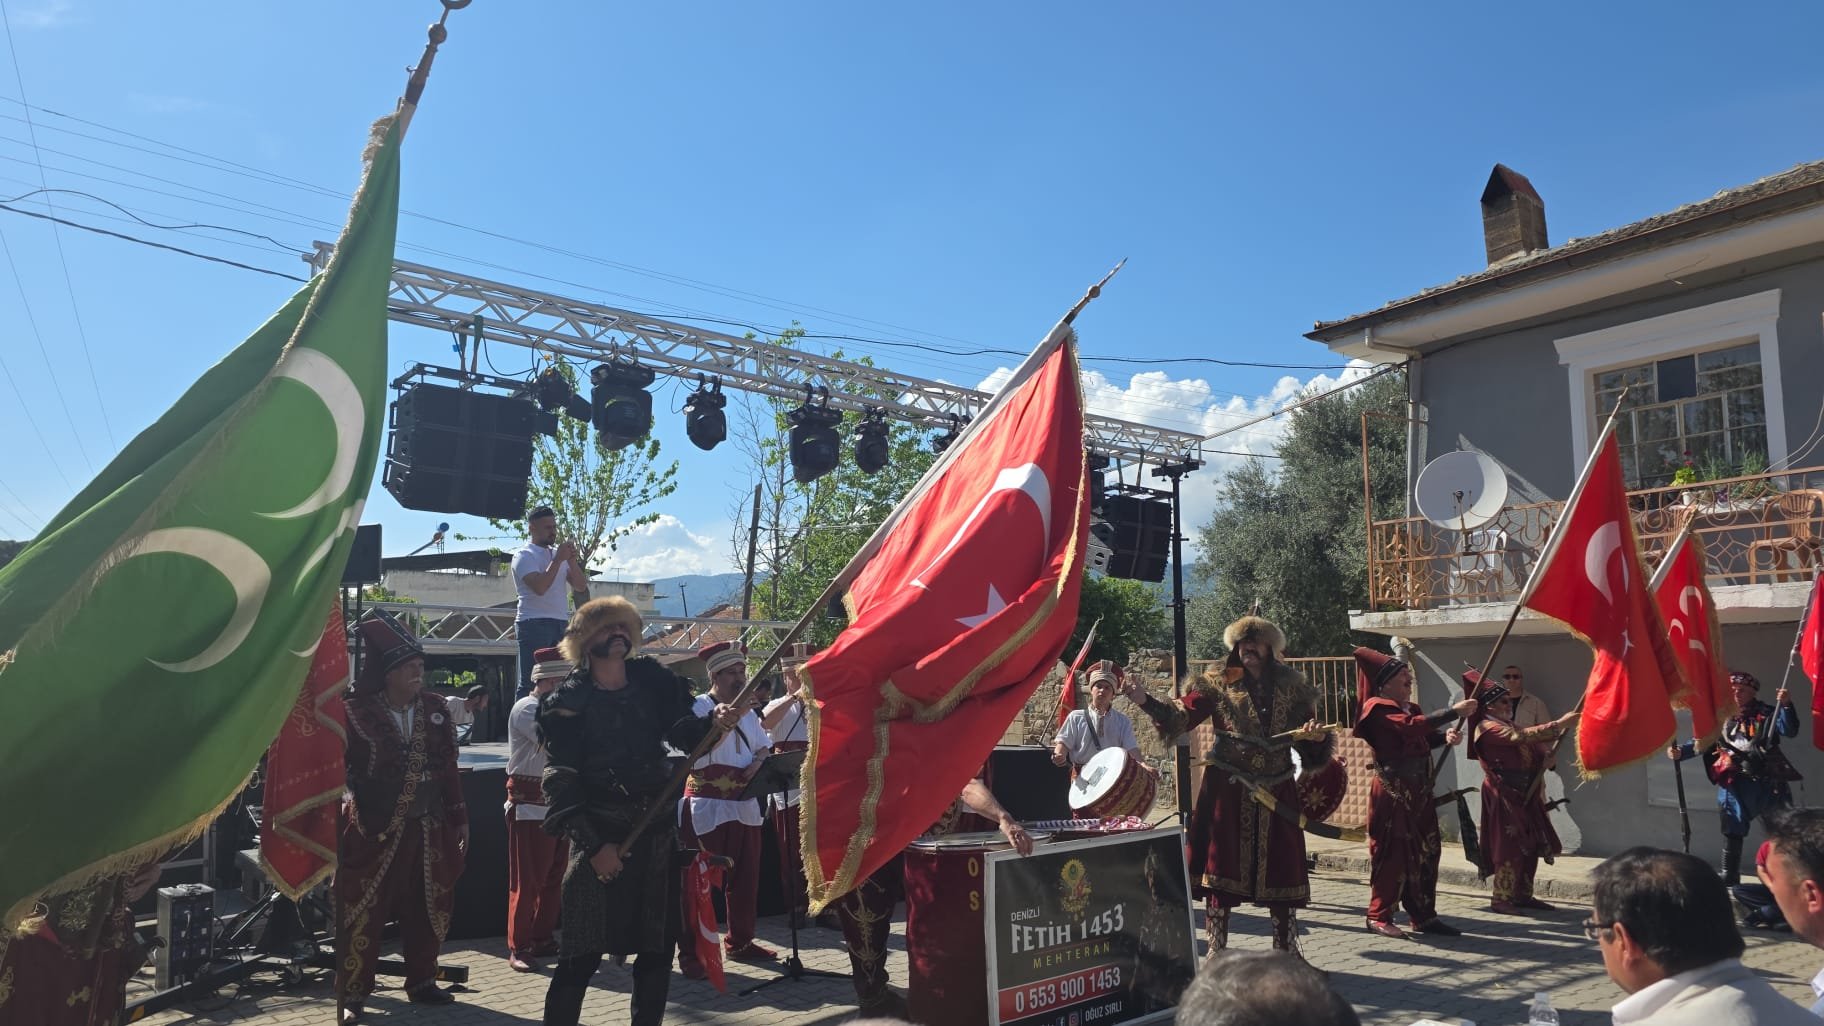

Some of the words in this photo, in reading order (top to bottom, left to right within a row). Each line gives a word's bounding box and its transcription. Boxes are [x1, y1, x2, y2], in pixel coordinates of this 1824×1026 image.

[1011, 906, 1040, 922] DENİZLİ
[1011, 921, 1071, 953] FETİH
[1080, 903, 1124, 939] 1453
[1033, 942, 1110, 969] MEHTERAN
[1015, 992, 1025, 1013] 0
[1029, 984, 1056, 1009] 553
[1060, 977, 1085, 1000] 900
[1089, 967, 1120, 992] 1453
[1085, 1006, 1103, 1021] OĞUZ
